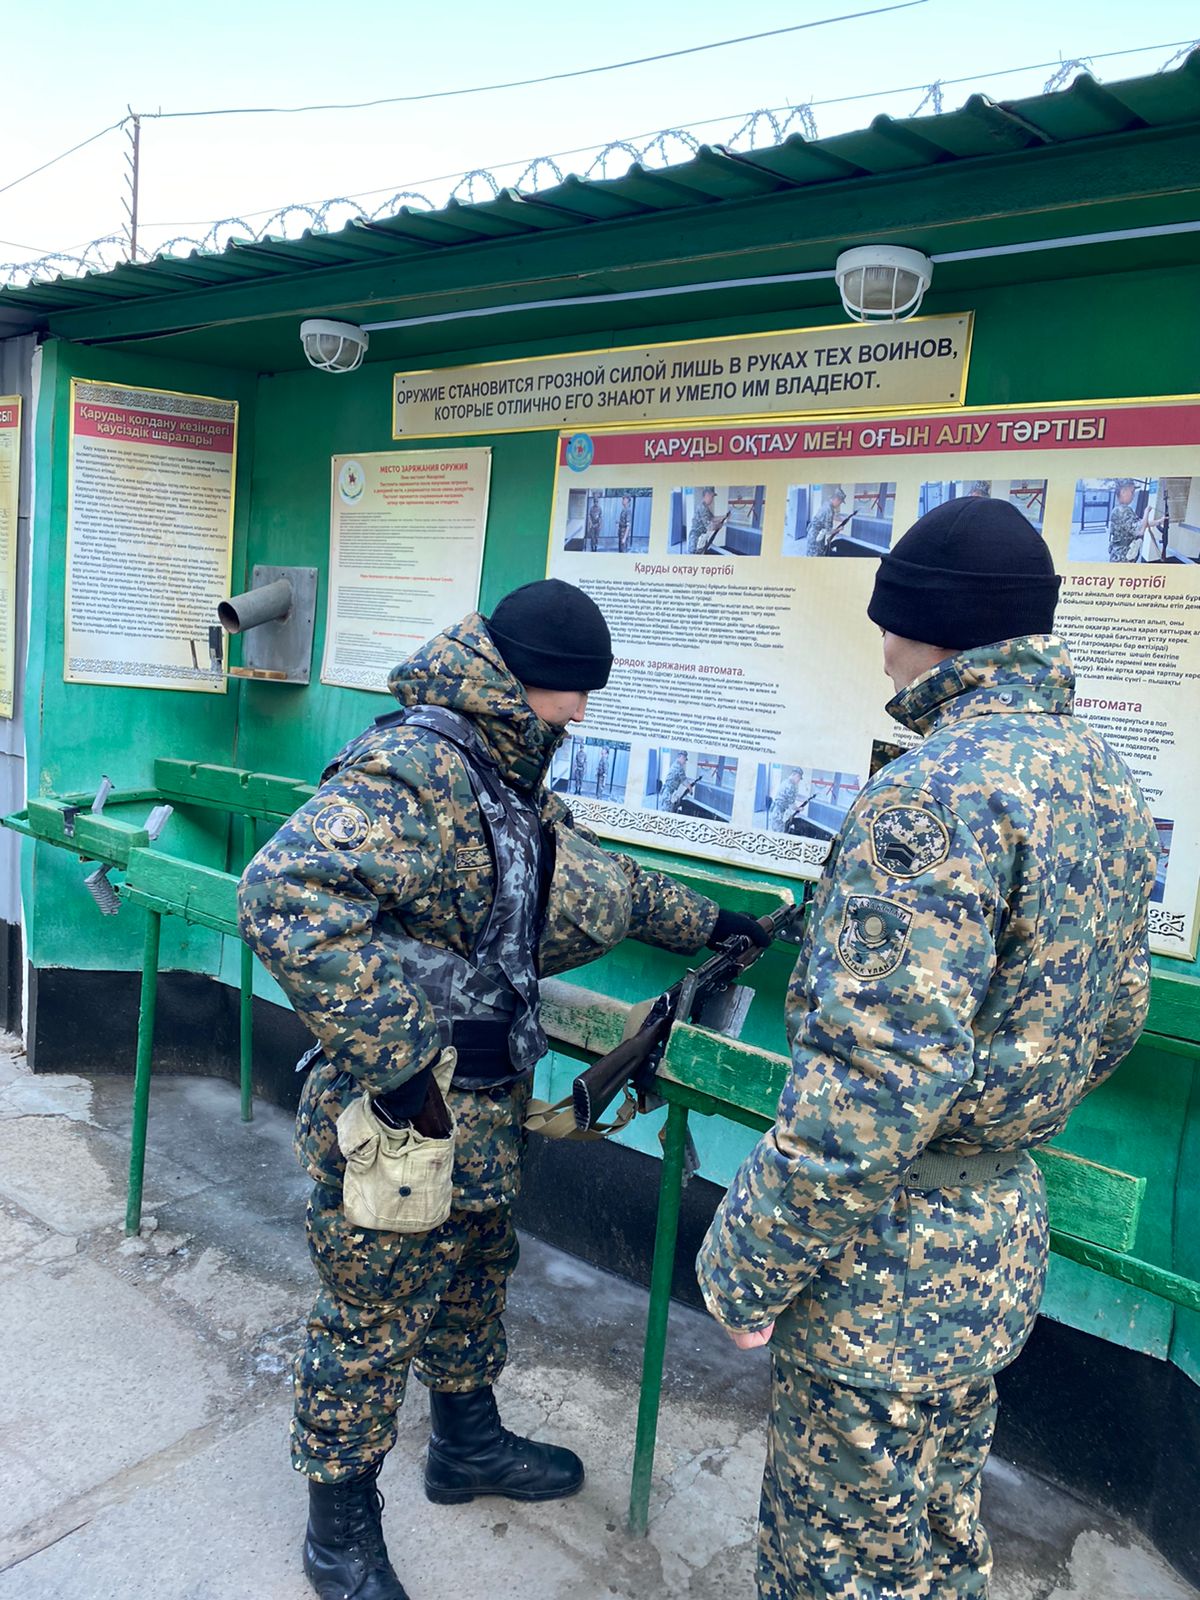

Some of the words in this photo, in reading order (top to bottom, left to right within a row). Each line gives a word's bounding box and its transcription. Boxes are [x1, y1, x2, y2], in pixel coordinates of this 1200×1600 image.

[397, 386, 445, 405] ОРУЖИЕ
[448, 376, 533, 400] СТАНОВИТСЯ
[537, 364, 605, 391] ГРОЗНОЙ
[608, 359, 666, 384] СИЛОЙ
[671, 360, 724, 379] ЛИШЬ
[729, 357, 742, 374] В
[747, 350, 808, 373] РУКАХ
[814, 346, 852, 367] ТЕХ
[857, 337, 959, 364] ВОИНОВ,
[434, 400, 494, 421] КОТОРЫЕ
[496, 394, 562, 416] ОТЛИЧНО
[565, 392, 594, 410] ЕГО
[597, 387, 656, 408] ЗНАЮТ
[659, 386, 672, 403] И
[676, 381, 737, 402] УМЕЛО
[742, 379, 769, 398] ИМ
[775, 370, 881, 396] ВЛАДЕЮТ.
[80, 406, 125, 423] Қаруды
[128, 414, 176, 432] қолдану
[180, 422, 230, 436] кезіндегі
[152, 430, 213, 446] шаралары
[644, 436, 723, 460] ҚАРУДЫ
[729, 433, 799, 456] ОҚТАУ
[803, 430, 853, 451] МЕН
[859, 425, 930, 449] ОҒЫН
[936, 422, 990, 445] АЛУ
[996, 417, 1107, 443] ТӘРТІБІ
[380, 465, 401, 473] МЕСТО
[402, 464, 439, 473] ЗАРЯЖАНИЯ
[440, 462, 469, 472] ОРУЖИЯ
[634, 562, 670, 575] Қаруды
[671, 564, 699, 577] оқтау
[701, 563, 735, 577] тәртібі
[1071, 575, 1115, 589] тастау
[1119, 575, 1166, 590] тәртібі
[613, 657, 645, 670] орядок
[647, 661, 696, 673] заряжания
[698, 664, 746, 677] автомата.
[1075, 697, 1143, 712] автомата
